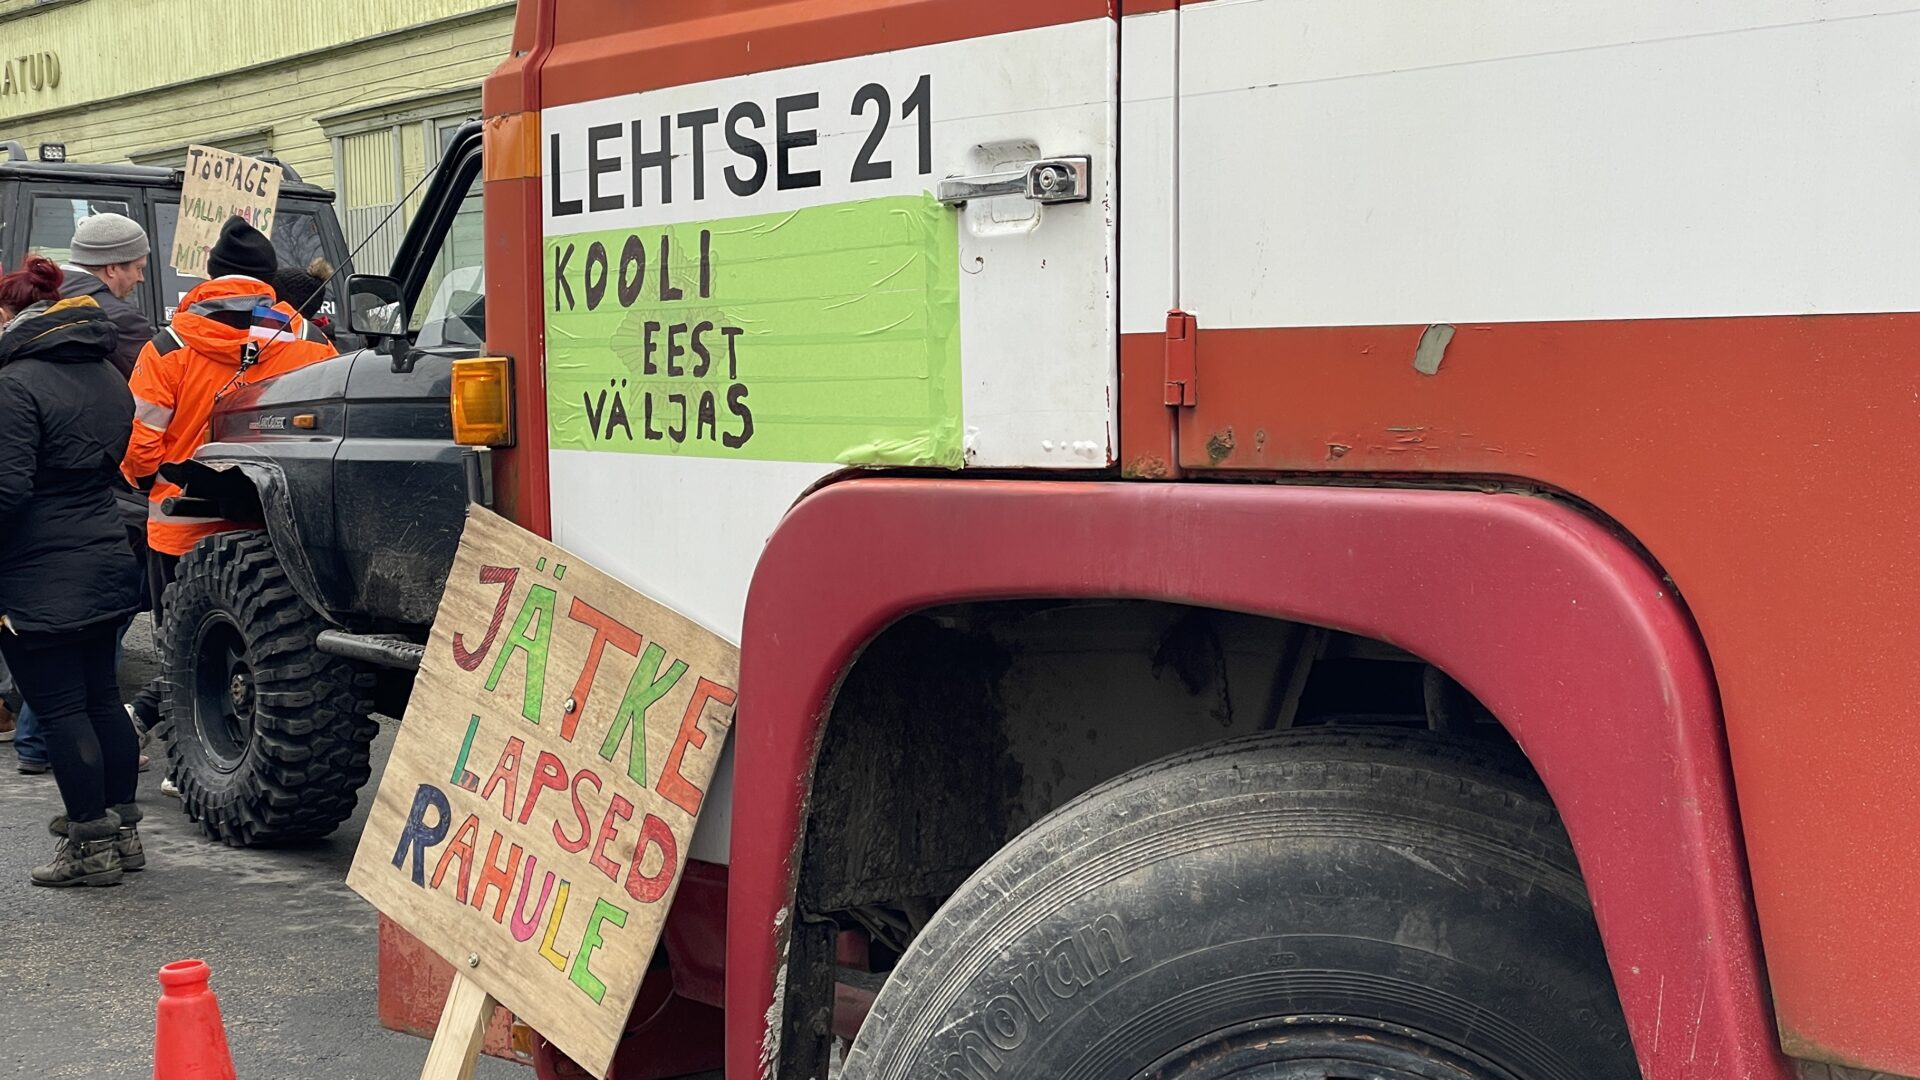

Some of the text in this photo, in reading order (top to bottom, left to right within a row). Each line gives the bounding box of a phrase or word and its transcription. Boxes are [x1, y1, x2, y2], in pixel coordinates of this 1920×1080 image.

[189, 149, 271, 198] TÖÖTAGE
[550, 74, 933, 217] LEHTSE 21
[183, 194, 224, 223] VALLA
[554, 229, 711, 312] KOOLI
[642, 320, 744, 380] EEST
[583, 378, 754, 450] VÄLJAS
[452, 556, 739, 818] JÄTKE
[450, 714, 679, 904] LAPSED
[391, 783, 629, 1006] RAHULE
